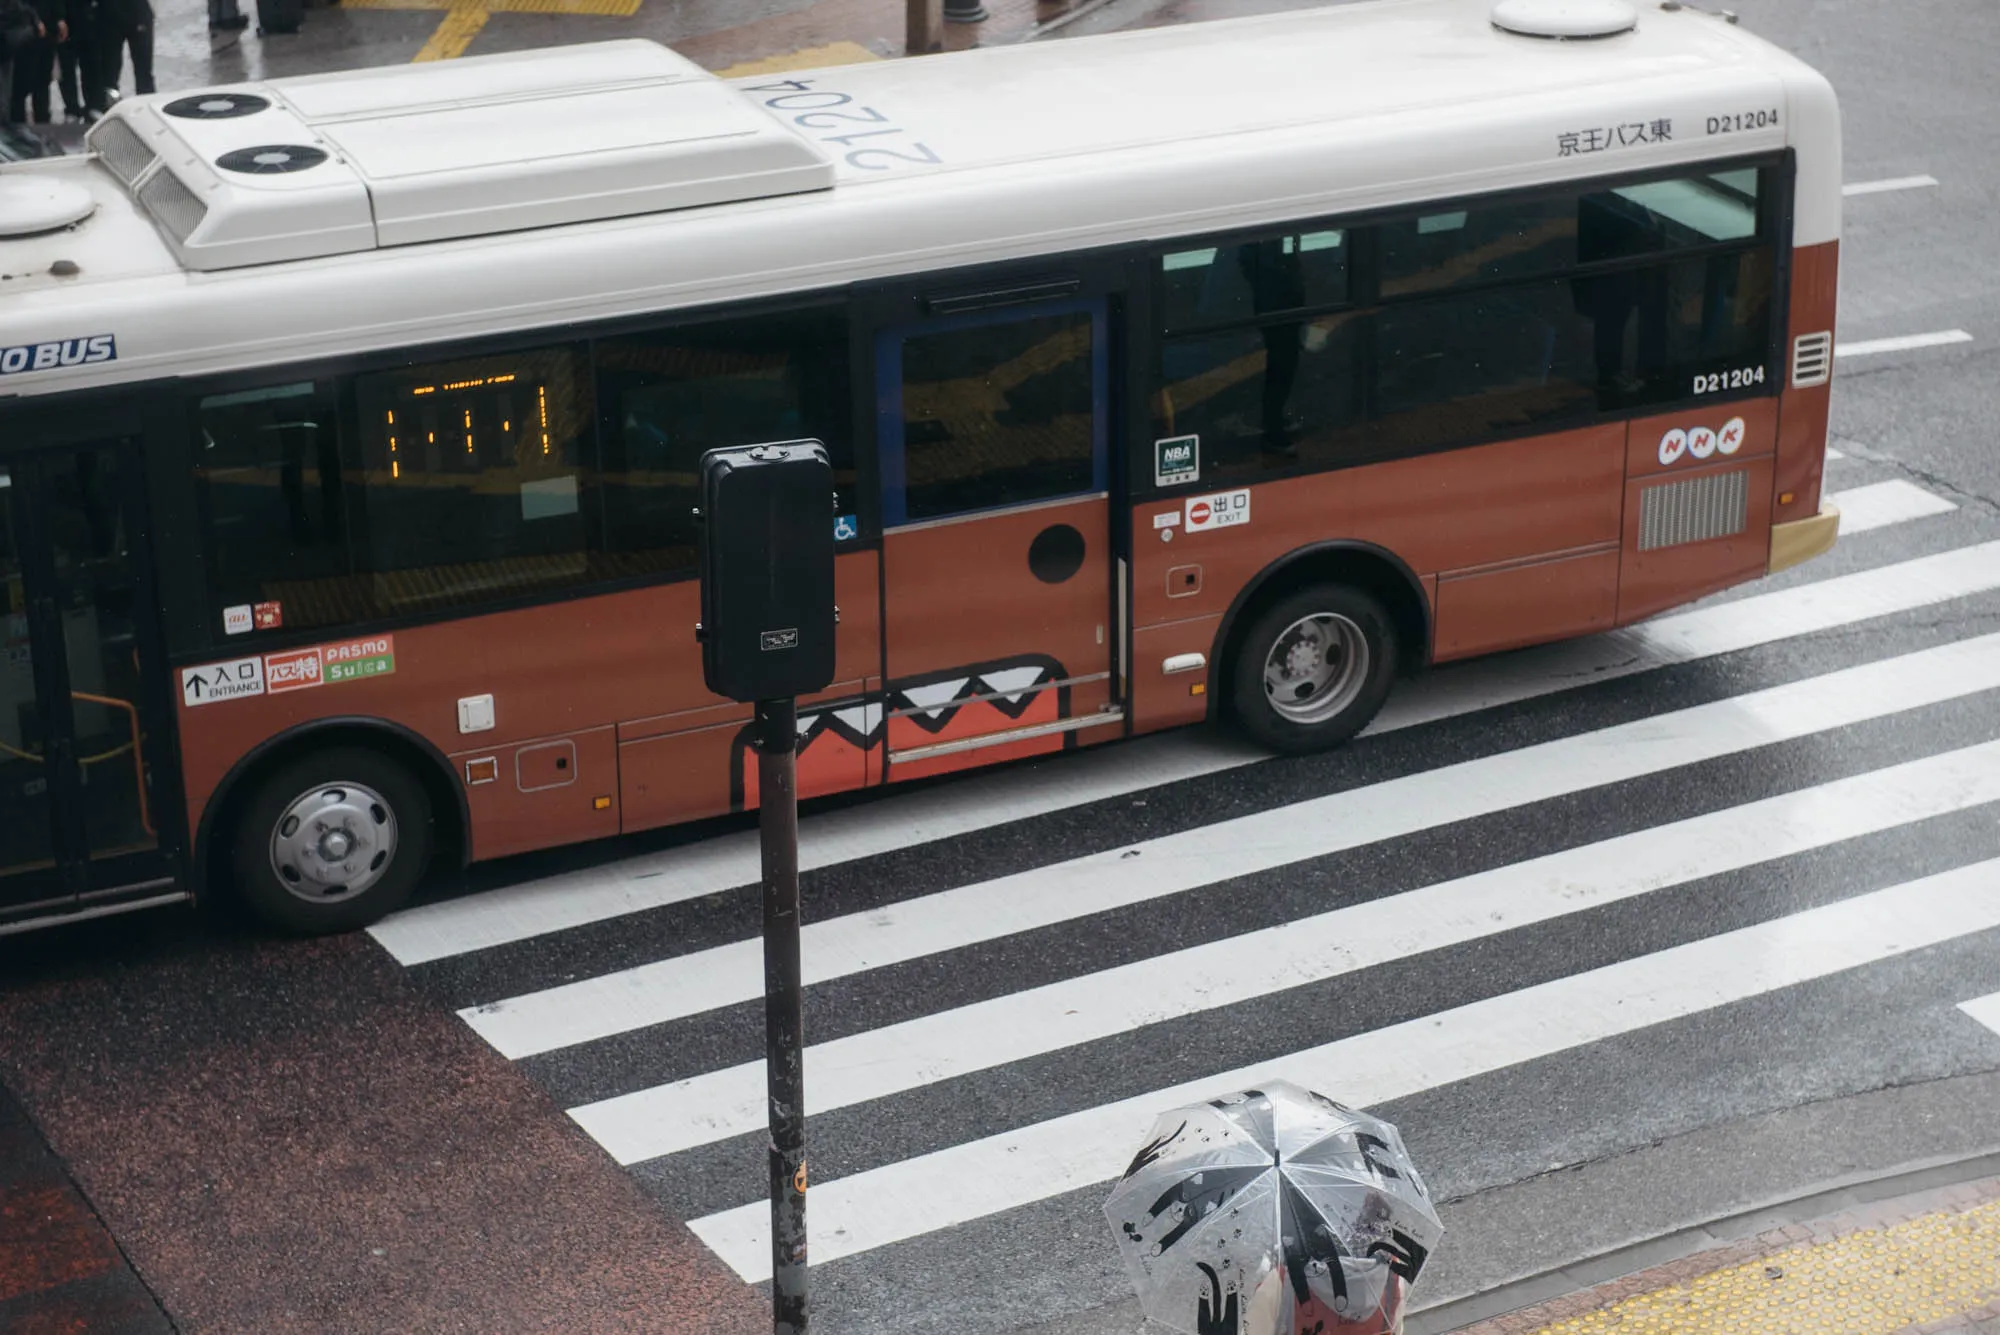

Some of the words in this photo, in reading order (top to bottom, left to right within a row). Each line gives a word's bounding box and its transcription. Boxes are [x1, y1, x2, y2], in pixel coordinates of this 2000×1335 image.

[739, 80, 944, 170] 21204
[1706, 109, 1778, 135] D21204
[1556, 118, 1673, 157] 京王バス東
[0, 346, 29, 373] O
[33, 335, 113, 370] BUS
[1692, 364, 1765, 395] D21204
[1164, 445, 1191, 461] NBA
[1213, 494, 1247, 513] 出口
[1216, 511, 1242, 524] EXIT
[327, 639, 388, 662] PASMO
[215, 663, 254, 685] 入口
[269, 656, 319, 683] バス特
[331, 658, 387, 679] Suica
[209, 680, 262, 698] ENTRANCE
